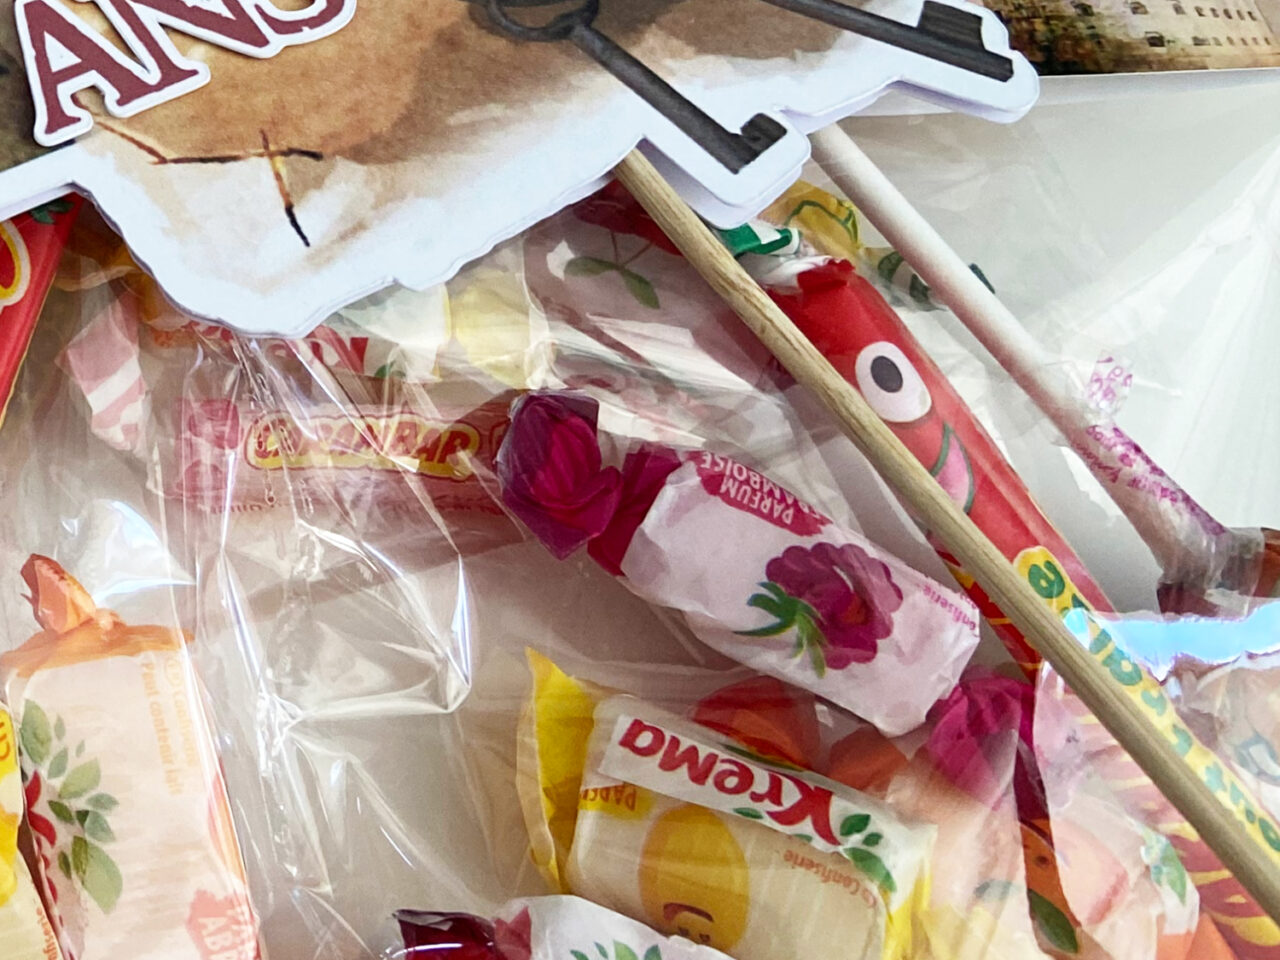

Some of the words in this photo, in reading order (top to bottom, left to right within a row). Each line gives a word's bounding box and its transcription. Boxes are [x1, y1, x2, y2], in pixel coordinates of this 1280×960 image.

[720, 476, 795, 526] PARFUM
[922, 583, 978, 640] onfiserie
[619, 719, 841, 846] Krema
